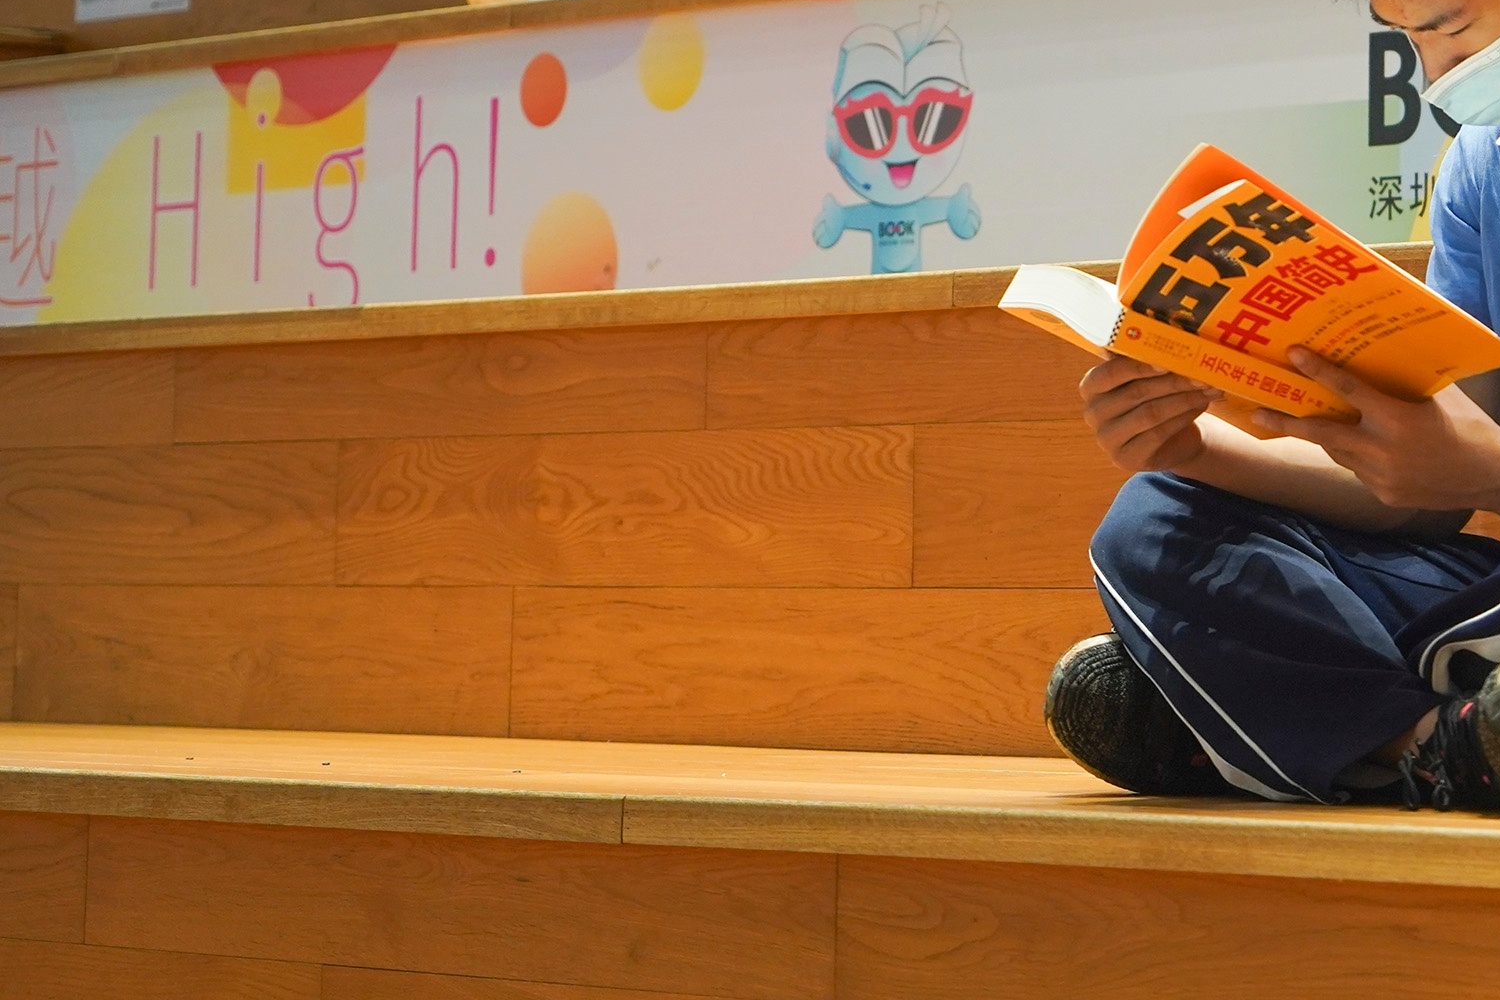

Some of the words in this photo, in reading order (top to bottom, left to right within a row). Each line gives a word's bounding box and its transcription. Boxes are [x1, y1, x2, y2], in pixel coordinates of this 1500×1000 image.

[146, 96, 500, 308] High!
[1131, 190, 1318, 335] 五万年
[1216, 244, 1380, 354] 中国简史
[1200, 352, 1308, 405] 五万年中国简史
